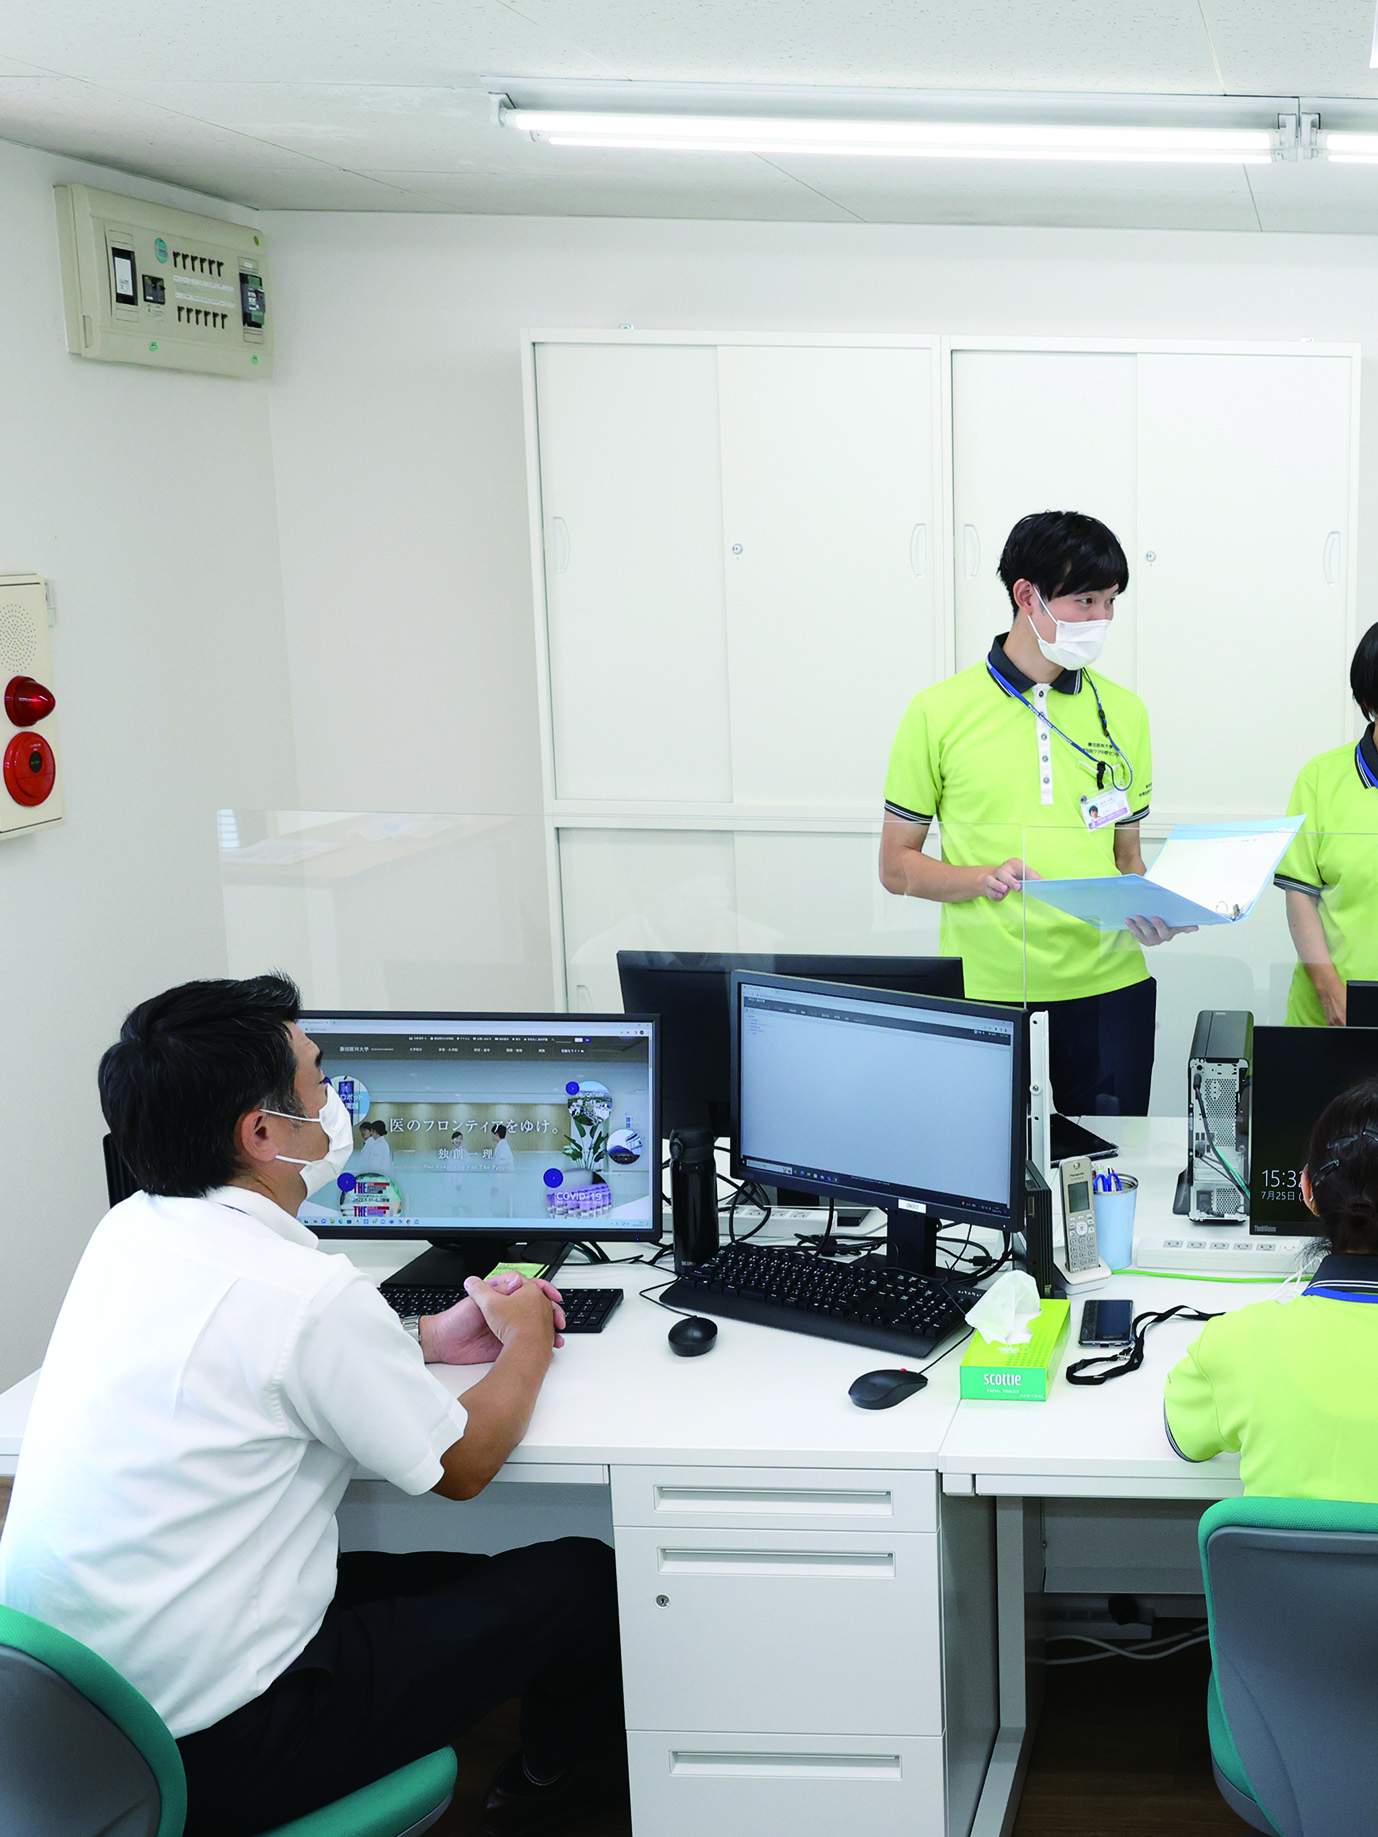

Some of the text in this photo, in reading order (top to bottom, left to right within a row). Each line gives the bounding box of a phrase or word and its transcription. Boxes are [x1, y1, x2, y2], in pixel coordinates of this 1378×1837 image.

[389, 1117, 559, 1135] 医のフロンティアをゆけ。
[438, 1148, 494, 1160] 独創一理
[556, 1192, 602, 1201] COVID-19
[1261, 1190, 1295, 1201] 7月25日
